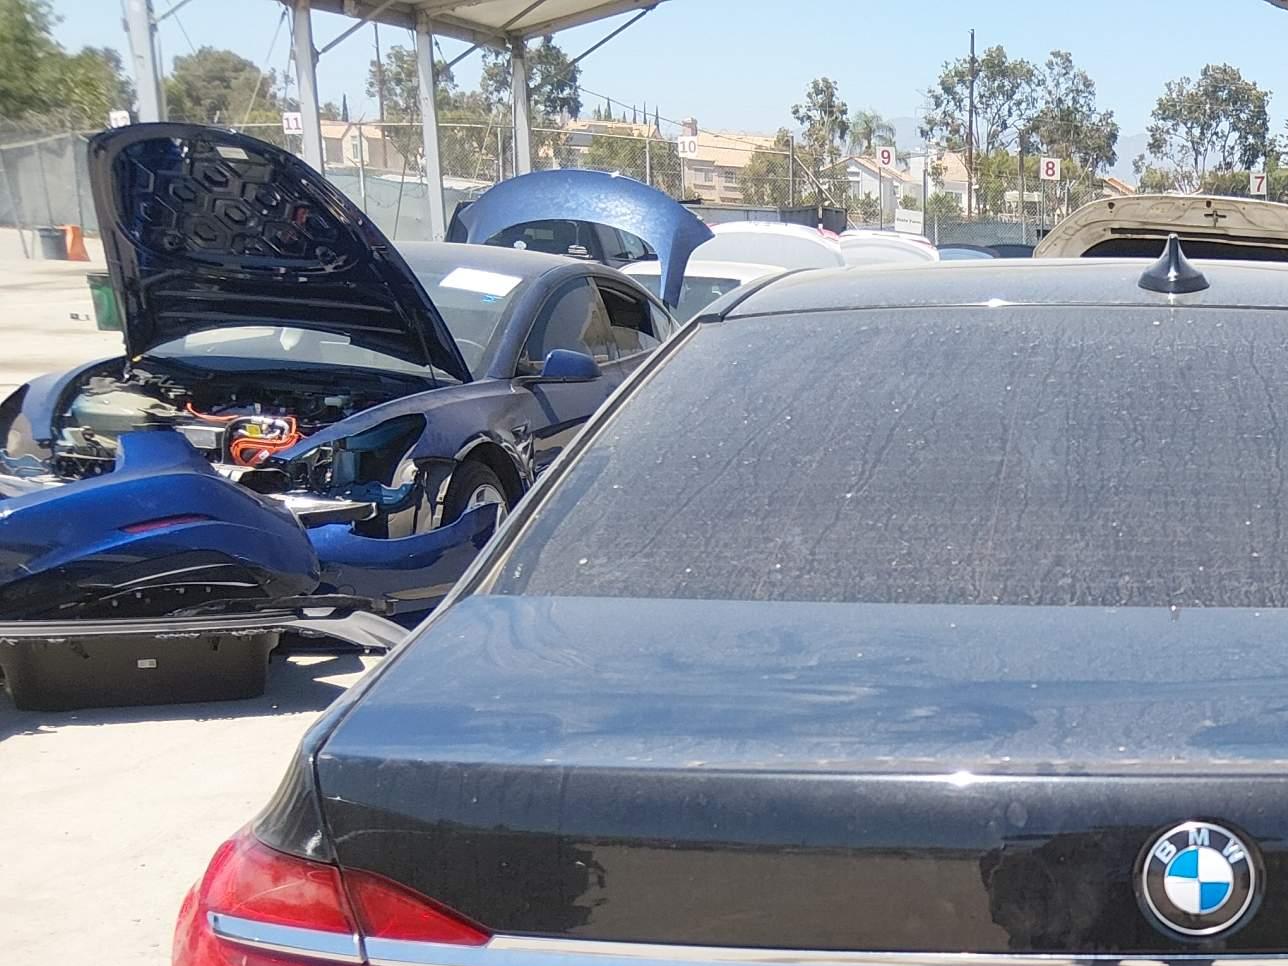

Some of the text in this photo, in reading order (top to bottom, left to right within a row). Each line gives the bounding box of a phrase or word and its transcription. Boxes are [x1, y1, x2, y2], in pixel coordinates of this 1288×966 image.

[284, 117, 302, 130] 11
[680, 140, 696, 153] 10
[881, 149, 891, 165] 9
[1045, 161, 1056, 177] 8
[1254, 175, 1265, 193] 7
[1154, 828, 1246, 865] BMW
